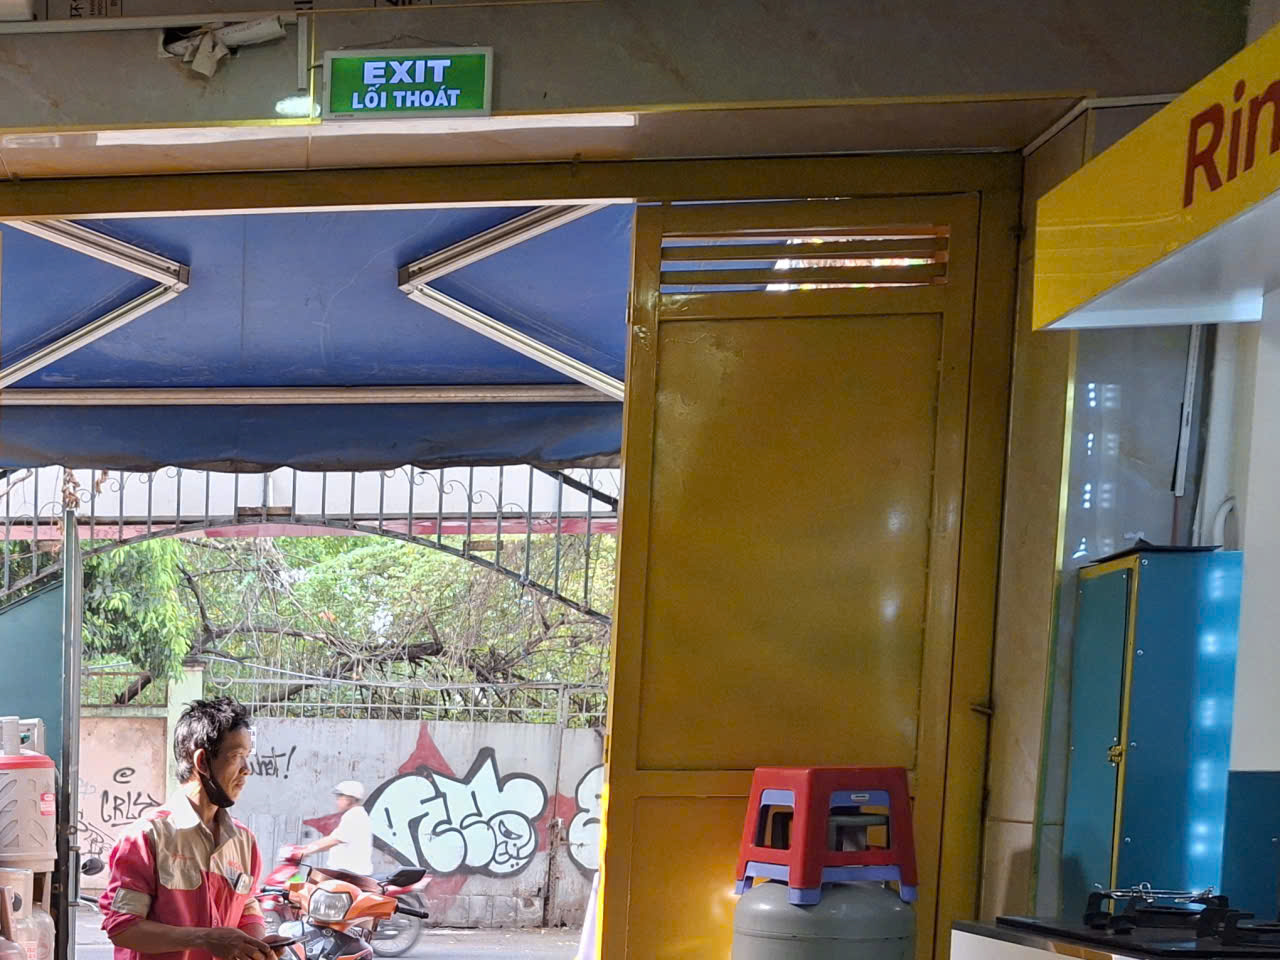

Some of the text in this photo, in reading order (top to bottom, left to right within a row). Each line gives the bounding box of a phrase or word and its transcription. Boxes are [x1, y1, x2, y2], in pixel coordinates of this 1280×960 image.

[363, 59, 451, 85] EXIT
[351, 84, 461, 109] LỐI THOÁT
